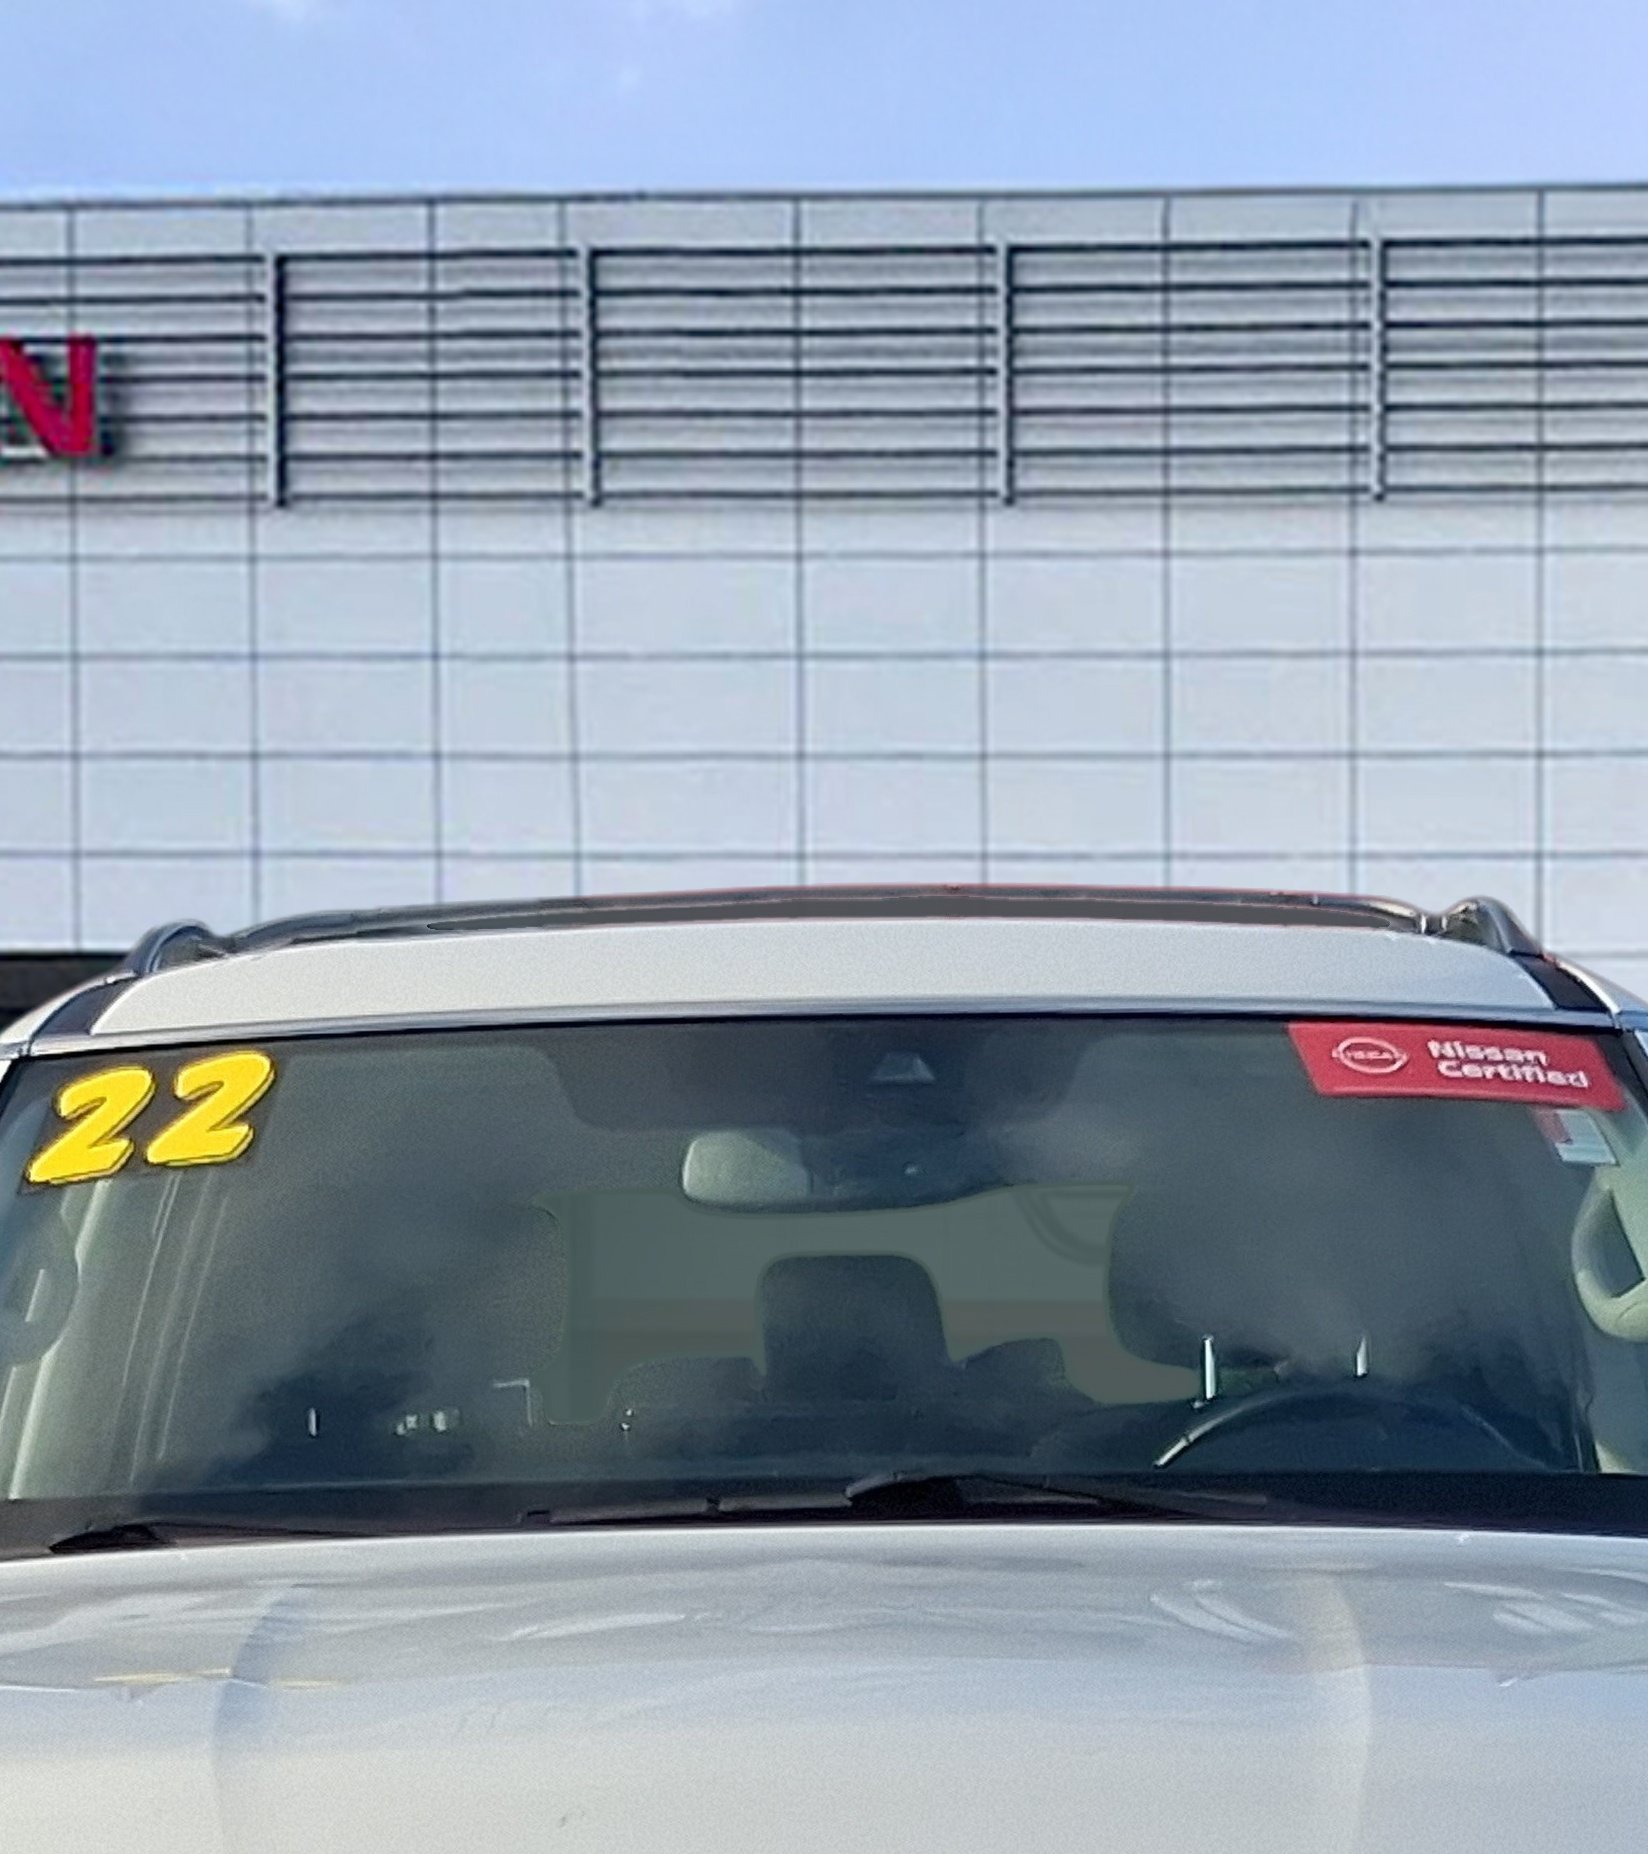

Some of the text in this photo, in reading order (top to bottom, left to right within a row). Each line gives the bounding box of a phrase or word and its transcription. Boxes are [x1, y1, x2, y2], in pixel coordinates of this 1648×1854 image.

[1427, 1038, 1549, 1068] Nissan
[1436, 1060, 1591, 1090] Certified
[26, 1048, 276, 1186] 22
